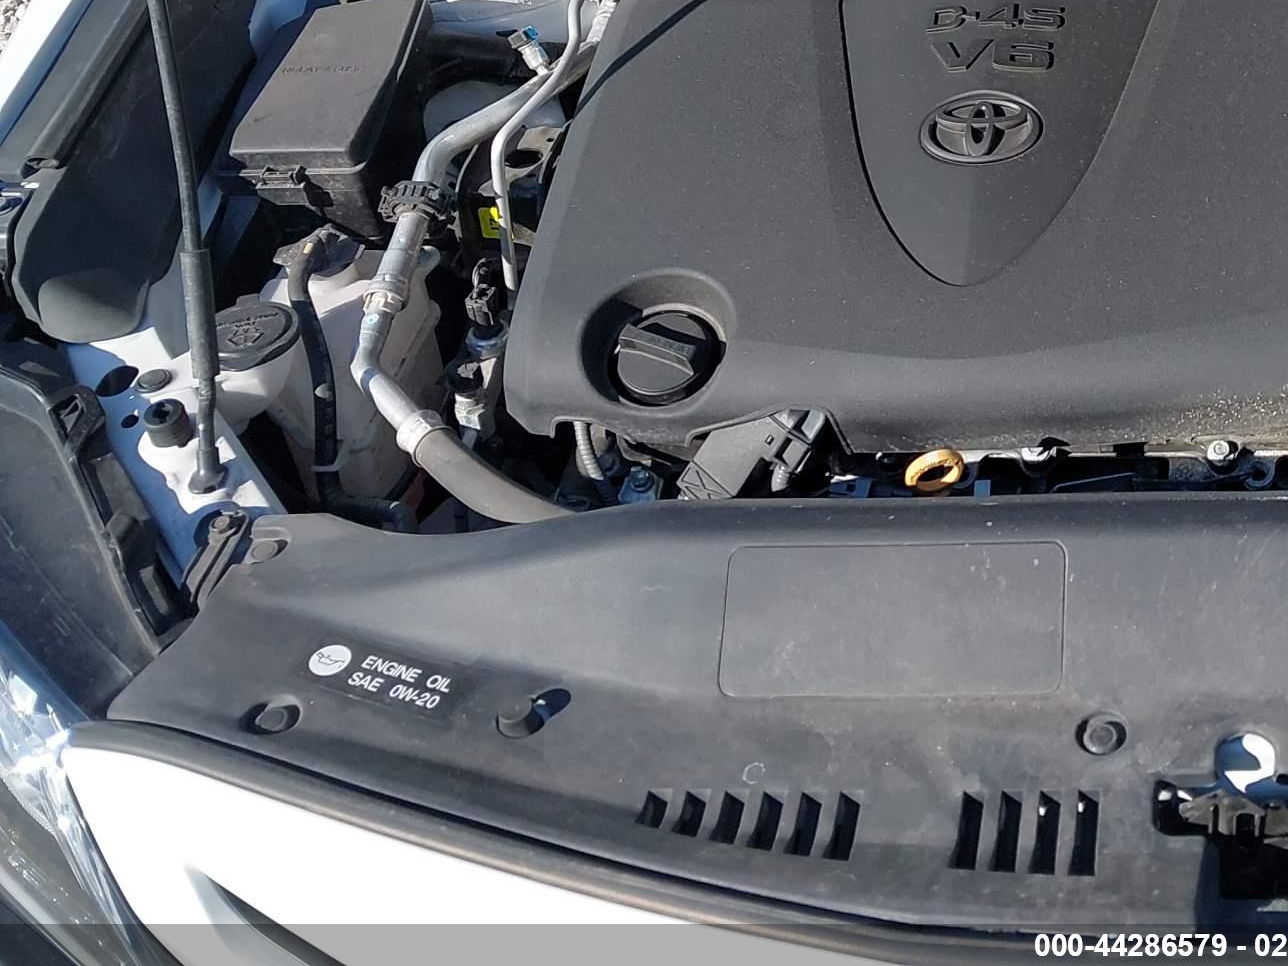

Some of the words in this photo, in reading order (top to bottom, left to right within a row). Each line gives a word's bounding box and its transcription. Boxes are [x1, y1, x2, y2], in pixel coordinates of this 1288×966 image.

[926, 2, 1066, 34] D-4S
[930, 38, 1055, 72] V6
[347, 672, 384, 692] SAE
[389, 684, 440, 709] 0W-20
[361, 655, 422, 683] ENGINE
[426, 675, 451, 693] OIL
